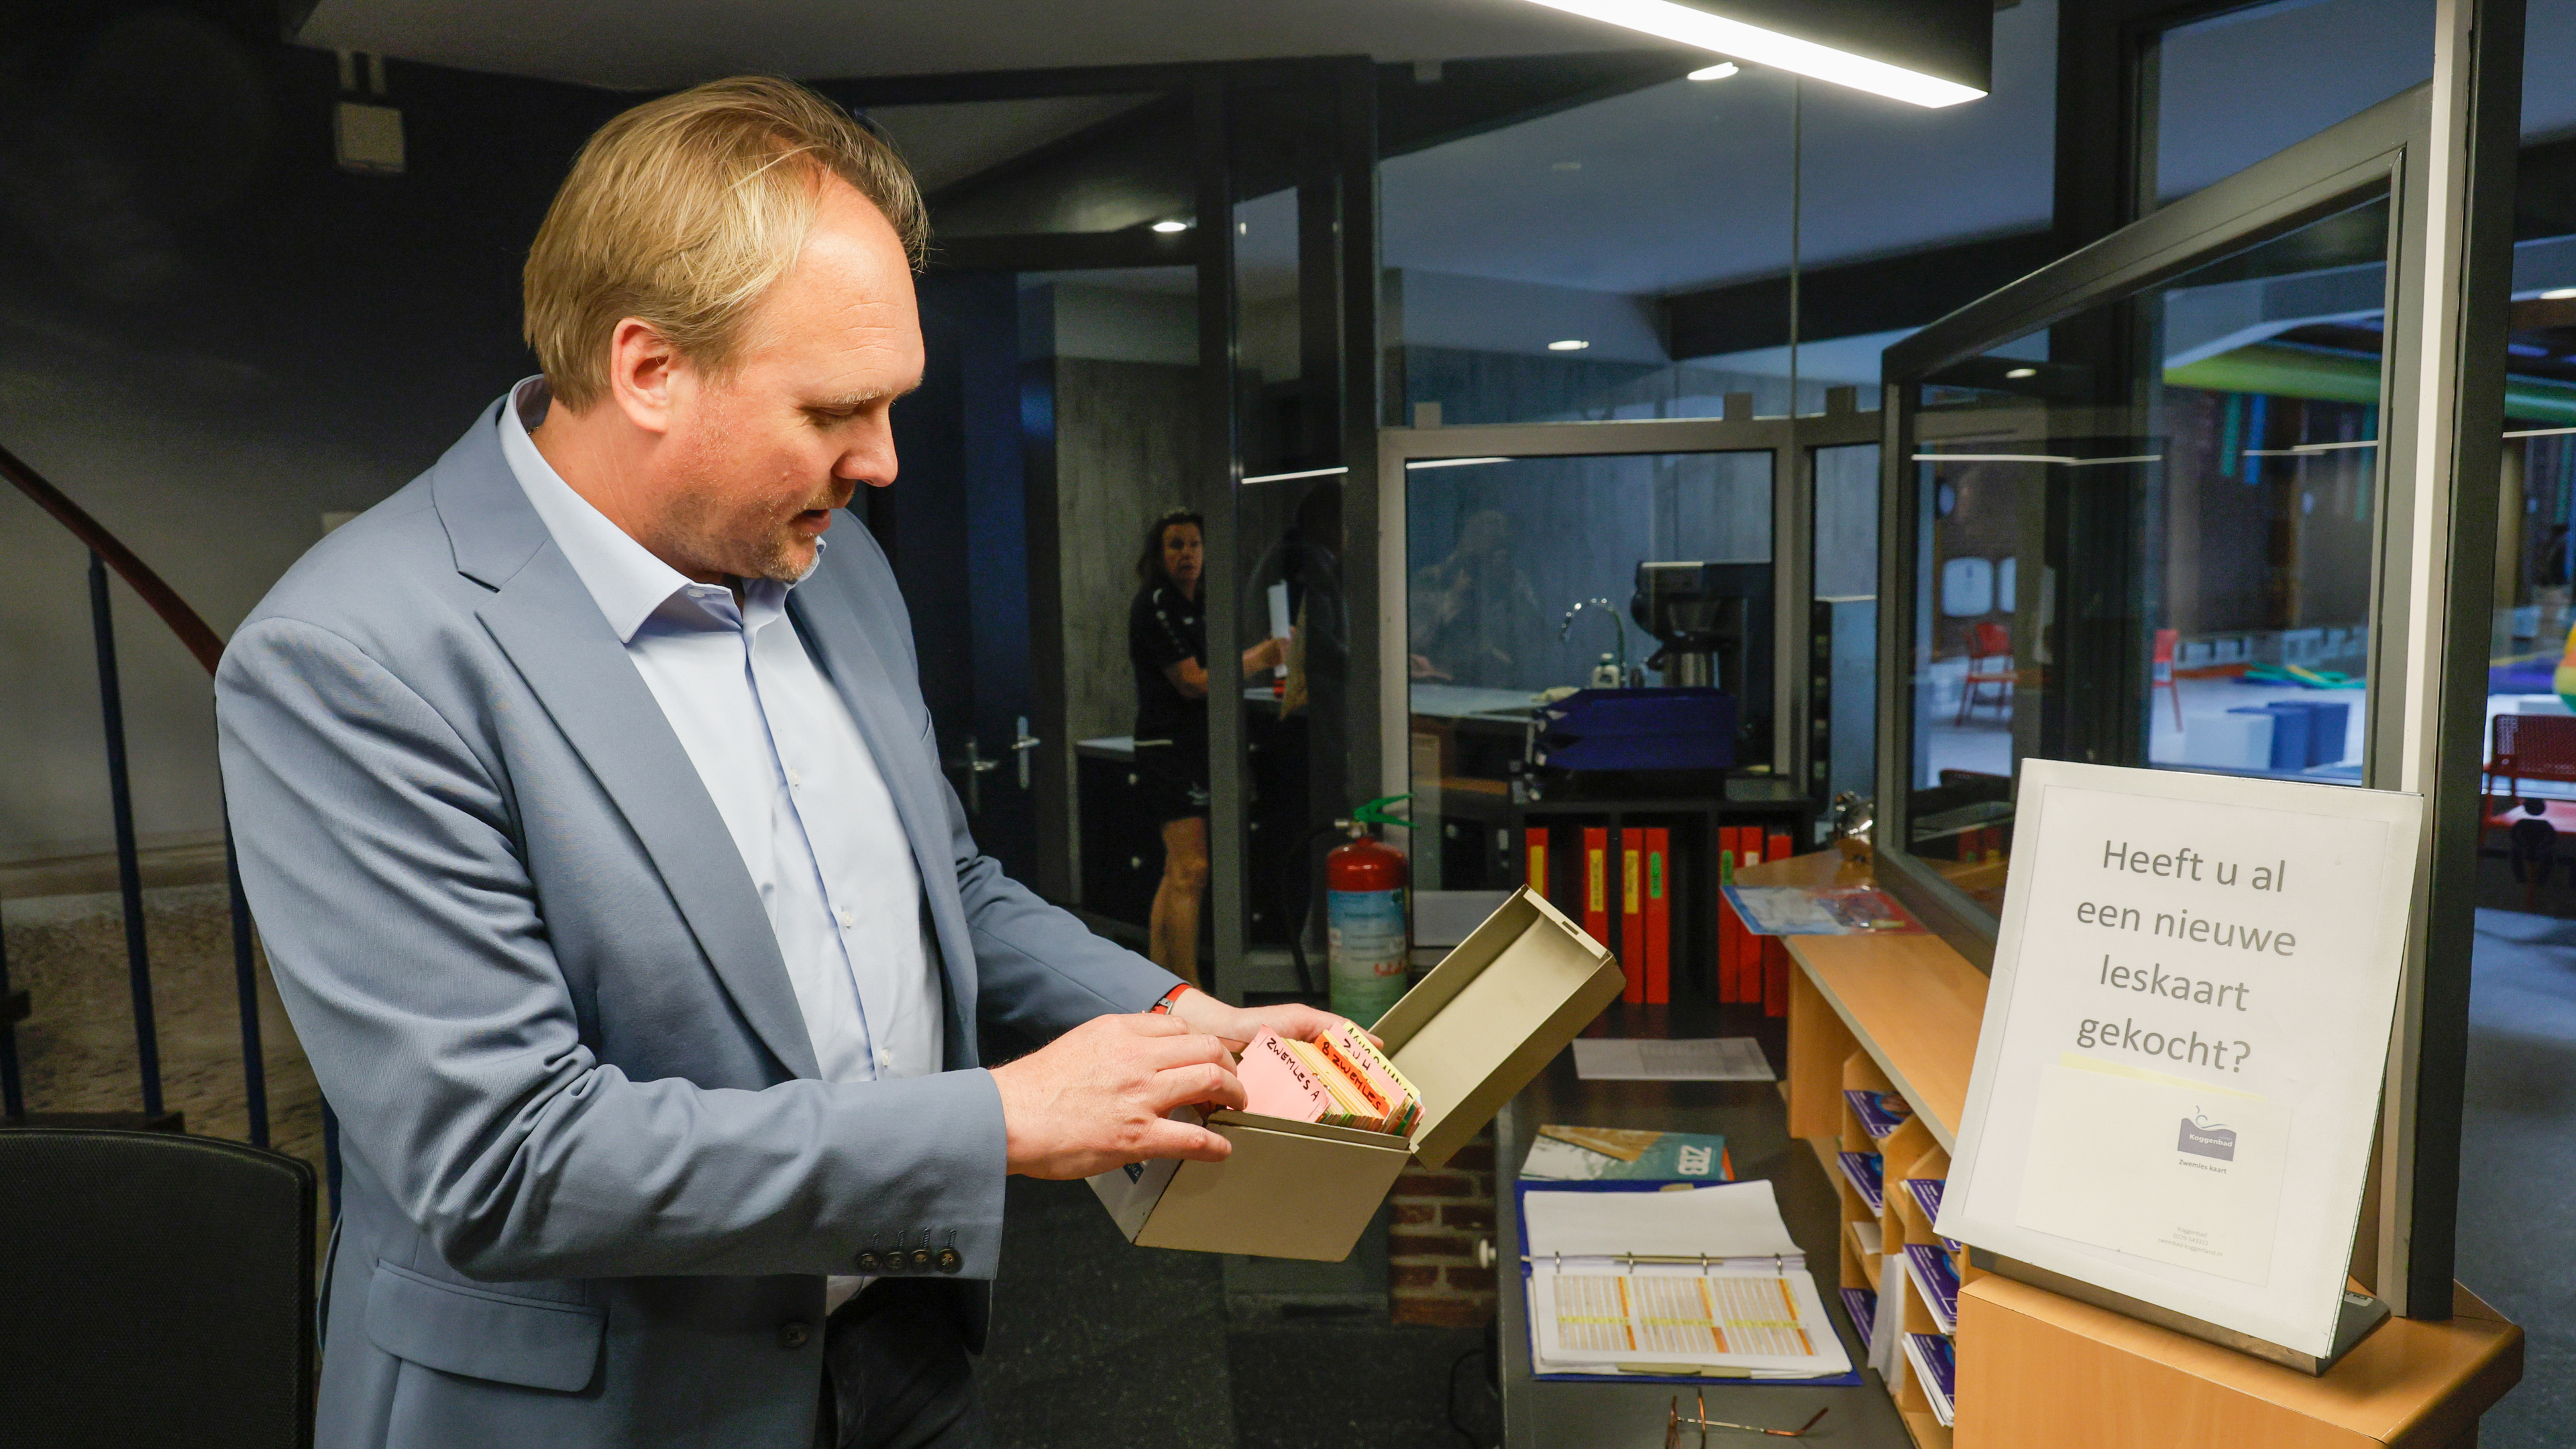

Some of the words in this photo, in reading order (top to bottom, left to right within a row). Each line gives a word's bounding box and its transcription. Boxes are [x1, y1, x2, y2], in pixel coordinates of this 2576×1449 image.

[2104, 840, 2204, 881] Heeft
[2216, 861, 2238, 886] u
[2252, 859, 2286, 892] al
[2077, 902, 2140, 932] een
[2155, 909, 2296, 956] nieuwe
[2100, 954, 2250, 1012] leskaart
[1266, 1037, 1311, 1091] ZWEMLES
[1310, 1090, 1320, 1102] A
[2077, 1018, 2251, 1073] gekocht?
[1332, 1053, 1382, 1111] ZWEMLES
[2179, 1159, 2208, 1171] Zwemles
[2209, 1165, 2227, 1174] kaart
[2189, 1133, 2233, 1147] Koggenbad
